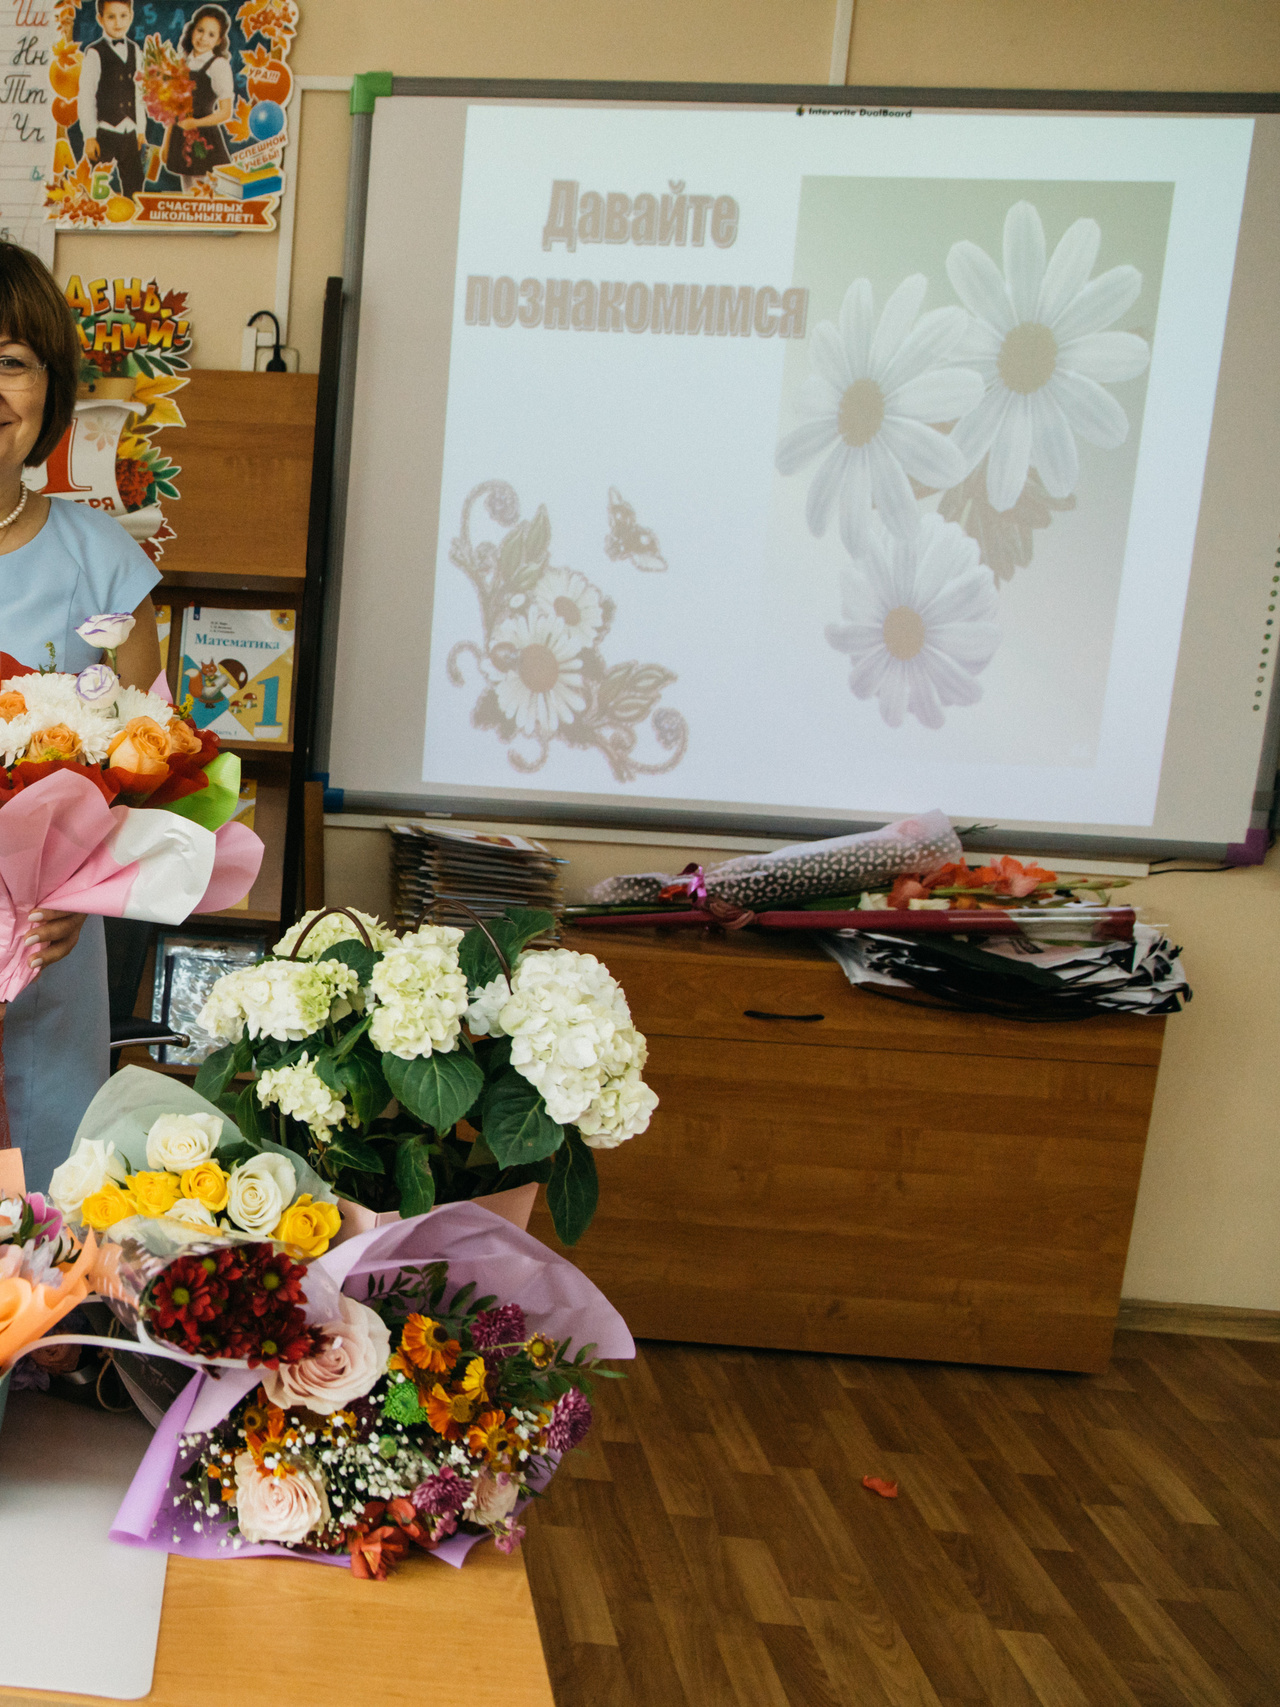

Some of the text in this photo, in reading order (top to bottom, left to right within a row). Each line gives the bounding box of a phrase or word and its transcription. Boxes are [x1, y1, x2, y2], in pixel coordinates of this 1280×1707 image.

[12, 36, 49, 66] Нн
[808, 107, 913, 118] Interwrite DualBoard
[12, 113, 45, 142] Чч
[233, 135, 286, 162] УСПЕШНОЙ
[149, 210, 254, 223] ШКОЛЬНЫХ ЛЕТ!
[157, 201, 243, 212] СЧАСТЛИВЫХ
[542, 179, 740, 253] Давайте
[464, 274, 810, 339] познакомимся
[76, 309, 190, 352] НИЙ!
[195, 633, 280, 649] Математика
[256, 675, 283, 726] 1
